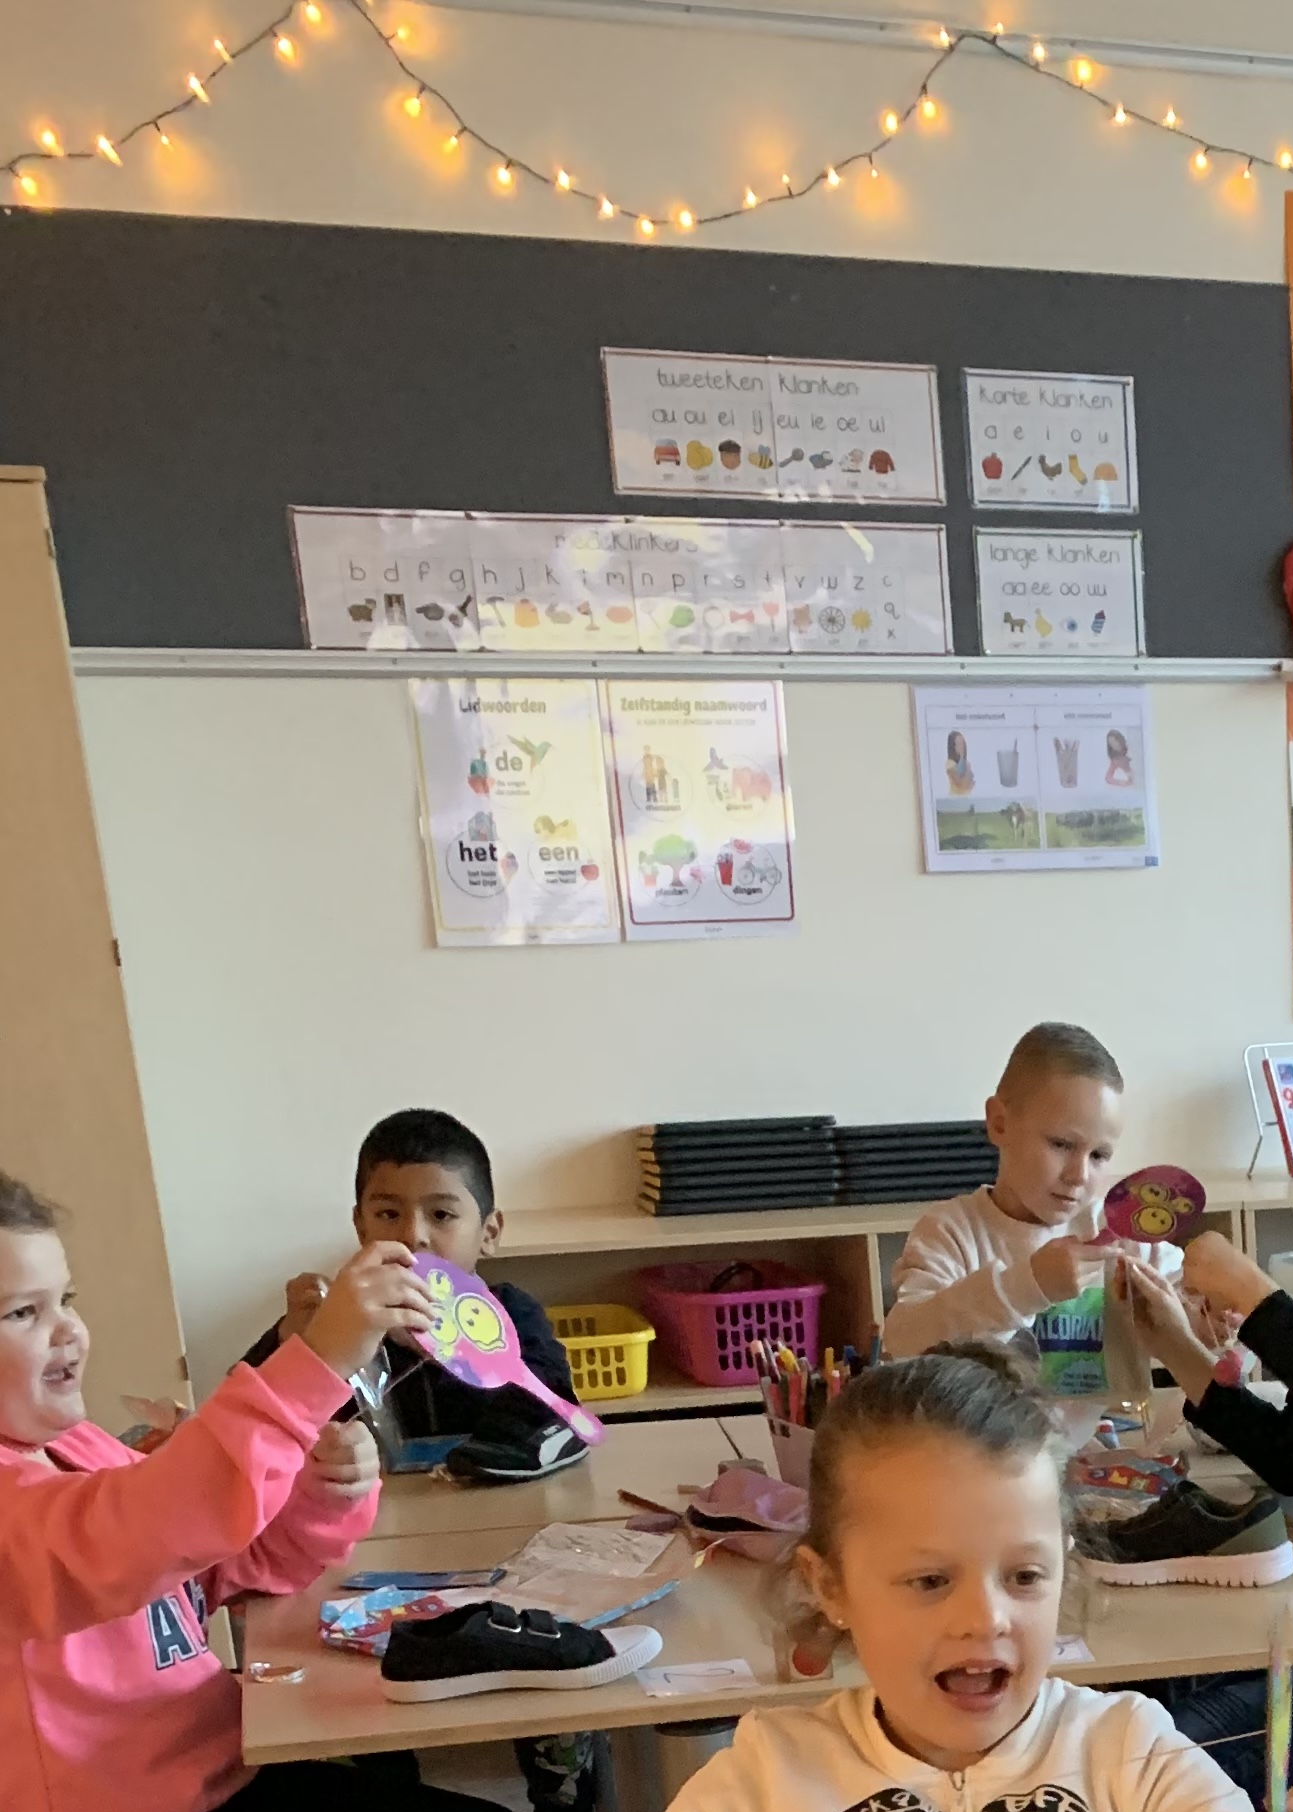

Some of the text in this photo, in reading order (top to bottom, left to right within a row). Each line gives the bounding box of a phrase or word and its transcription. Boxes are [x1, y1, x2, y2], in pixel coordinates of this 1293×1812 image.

[350, 560, 366, 582] b
[384, 561, 399, 582] d
[450, 568, 466, 591] g
[481, 565, 497, 584] h
[516, 567, 525, 592] j
[459, 697, 546, 713] Lidwoorden
[621, 697, 767, 716] Zelfstandig naamwoord
[495, 752, 523, 772] de
[459, 841, 498, 862] het
[539, 845, 579, 861] een
